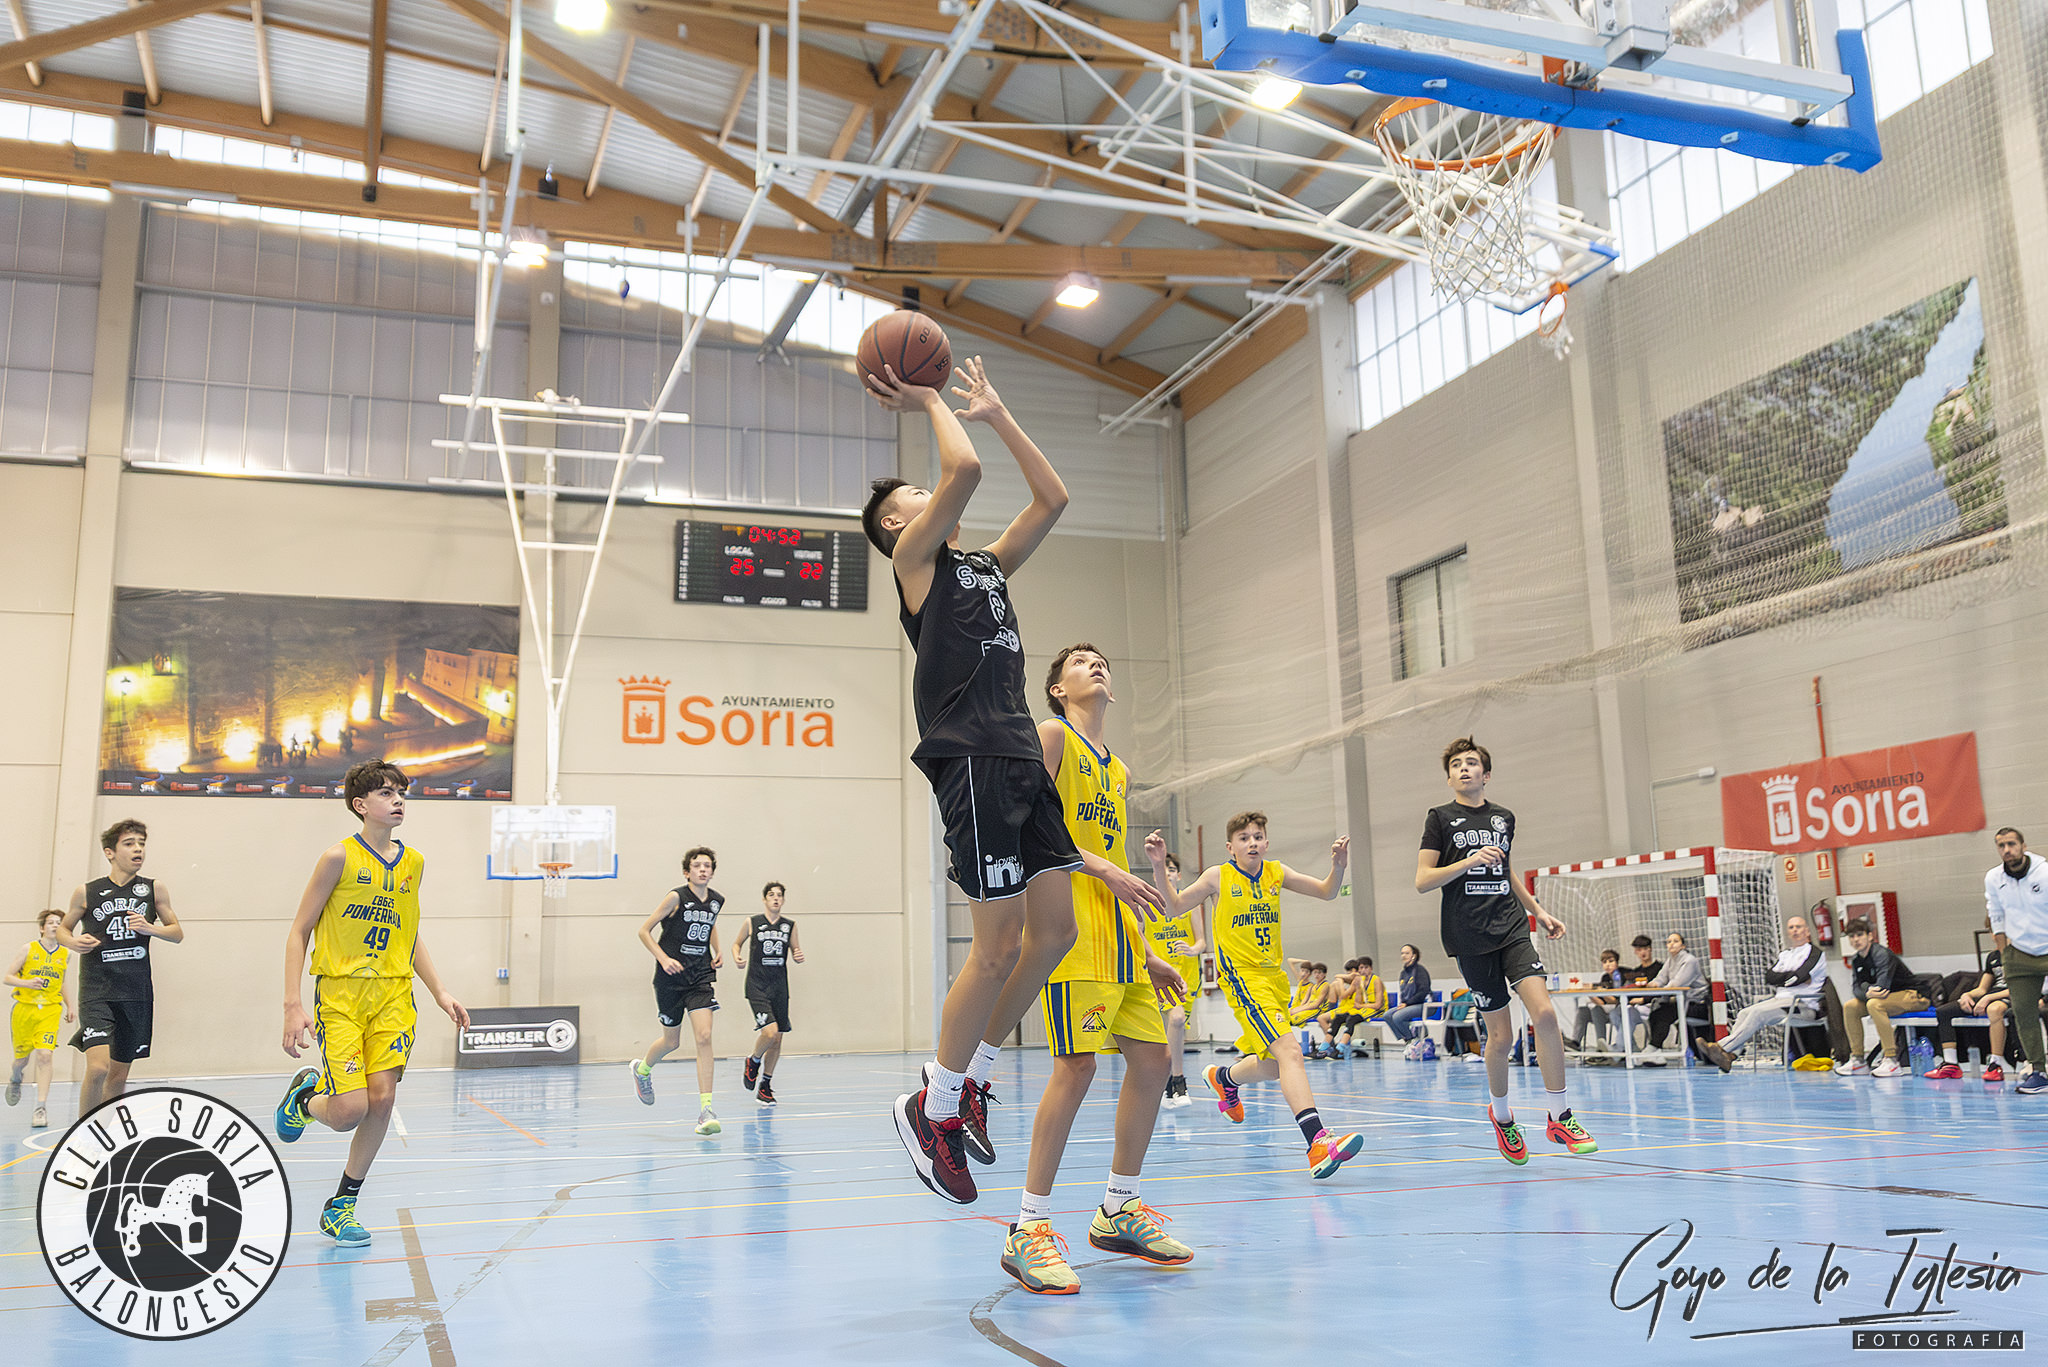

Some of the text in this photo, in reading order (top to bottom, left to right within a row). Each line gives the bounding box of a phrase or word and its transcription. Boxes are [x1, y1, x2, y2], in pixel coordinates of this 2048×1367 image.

[749, 526, 801, 545] 04:52
[730, 558, 754, 576] 25
[800, 562, 823, 580] 22
[722, 695, 835, 709] AYUNTAMIENTO
[676, 695, 835, 748] Soria
[1831, 770, 1925, 796] AYUNTAMIENTO
[1806, 785, 1930, 840] Soria
[1453, 829, 1510, 851] SORIA
[93, 898, 148, 921] SORIA
[363, 926, 391, 951] 49
[1255, 927, 1271, 946] 55
[763, 940, 783, 955] 84
[464, 1030, 546, 1045] TRANSLER
